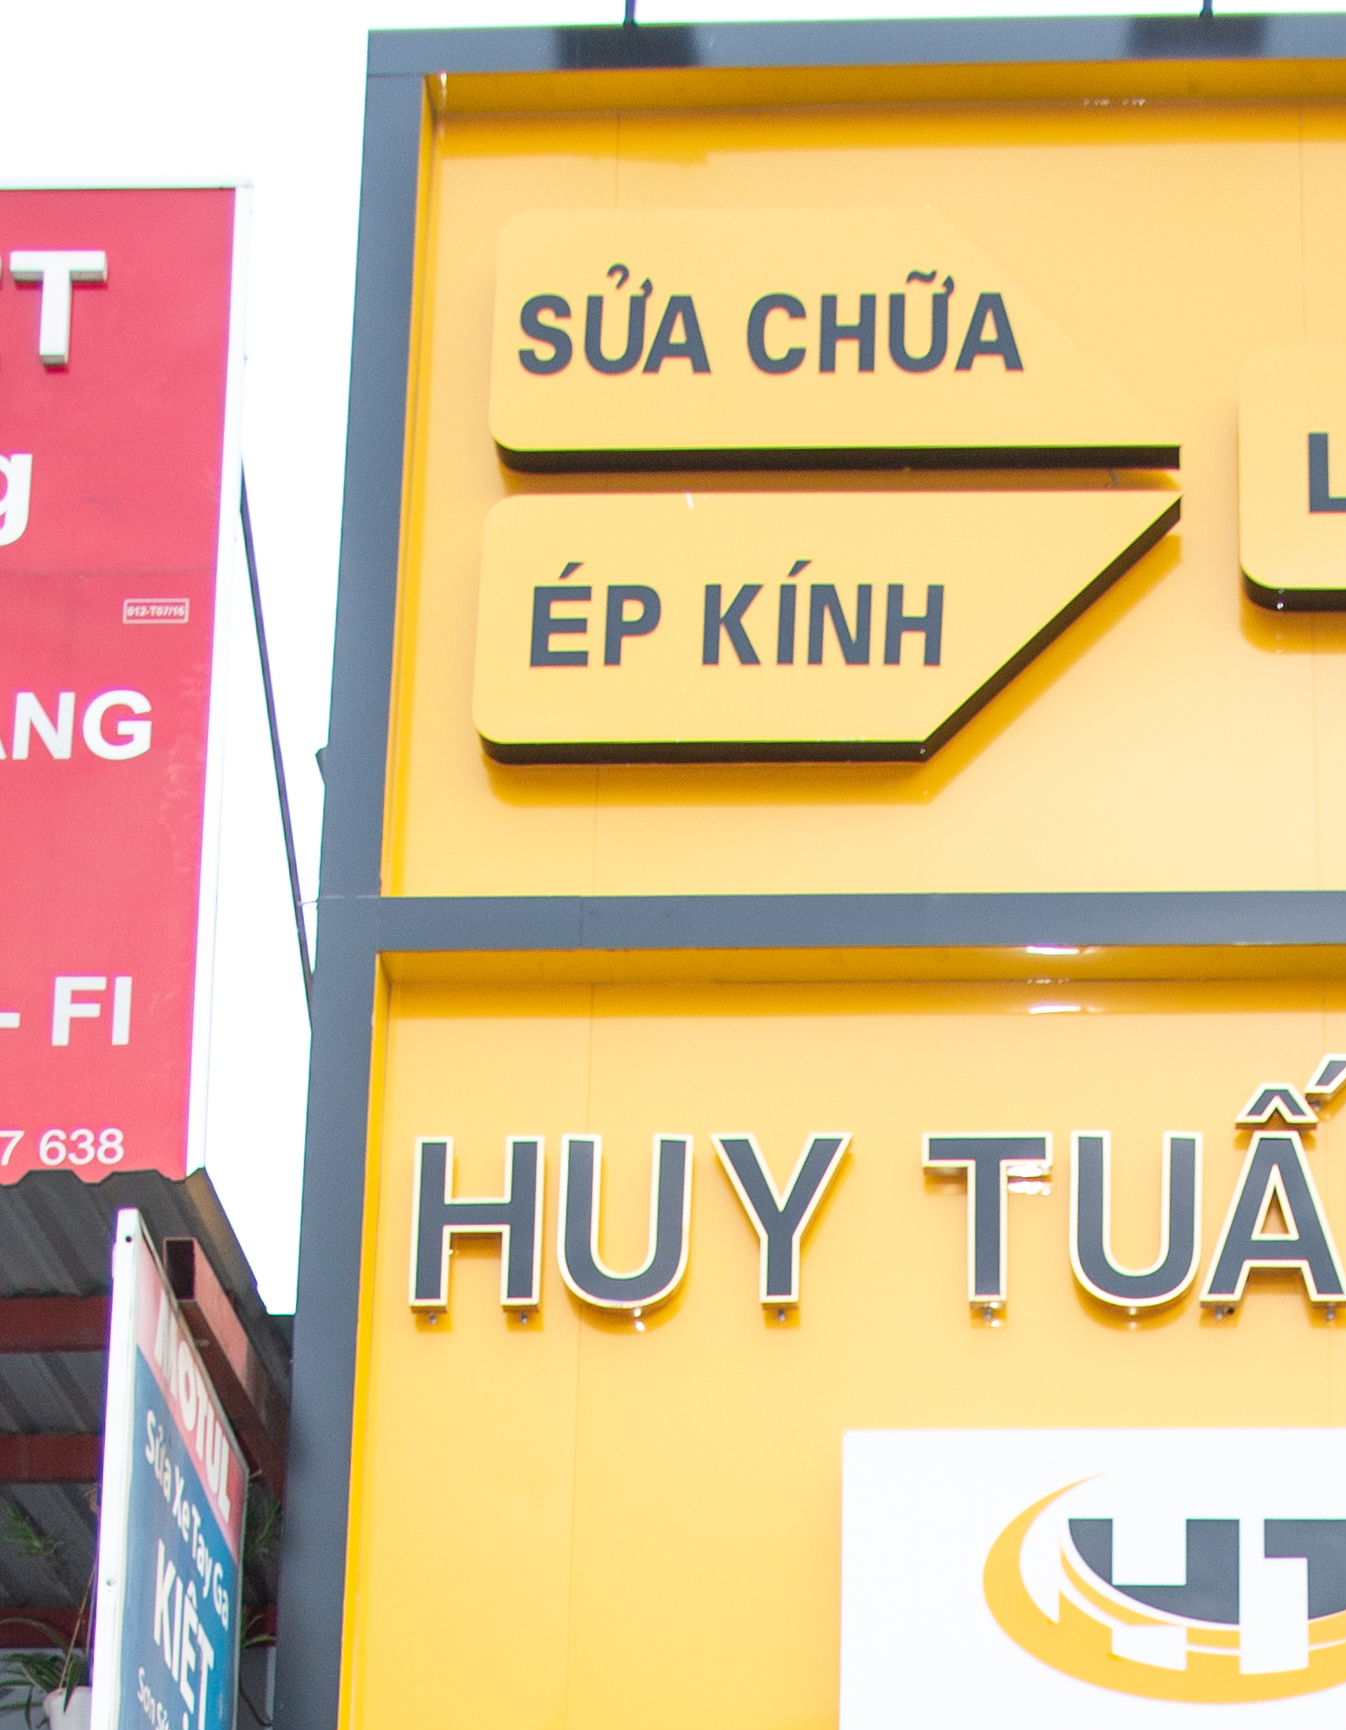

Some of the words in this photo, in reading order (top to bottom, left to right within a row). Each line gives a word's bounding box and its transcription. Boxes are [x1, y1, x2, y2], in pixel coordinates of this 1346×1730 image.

[0, 250, 108, 365] T
[519, 263, 710, 374] SỬA
[747, 270, 1023, 373] CHỮA
[530, 562, 661, 666] ÉP
[702, 560, 944, 665] KÍNH
[0, 690, 152, 760] NG
[39, 1128, 124, 1165] 638
[408, 1129, 853, 1314] HUY
[154, 1289, 231, 1523] MOTUL
[172, 1465, 191, 1542] Xe
[191, 1503, 213, 1599] Tay
[212, 1562, 229, 1631] Ga
